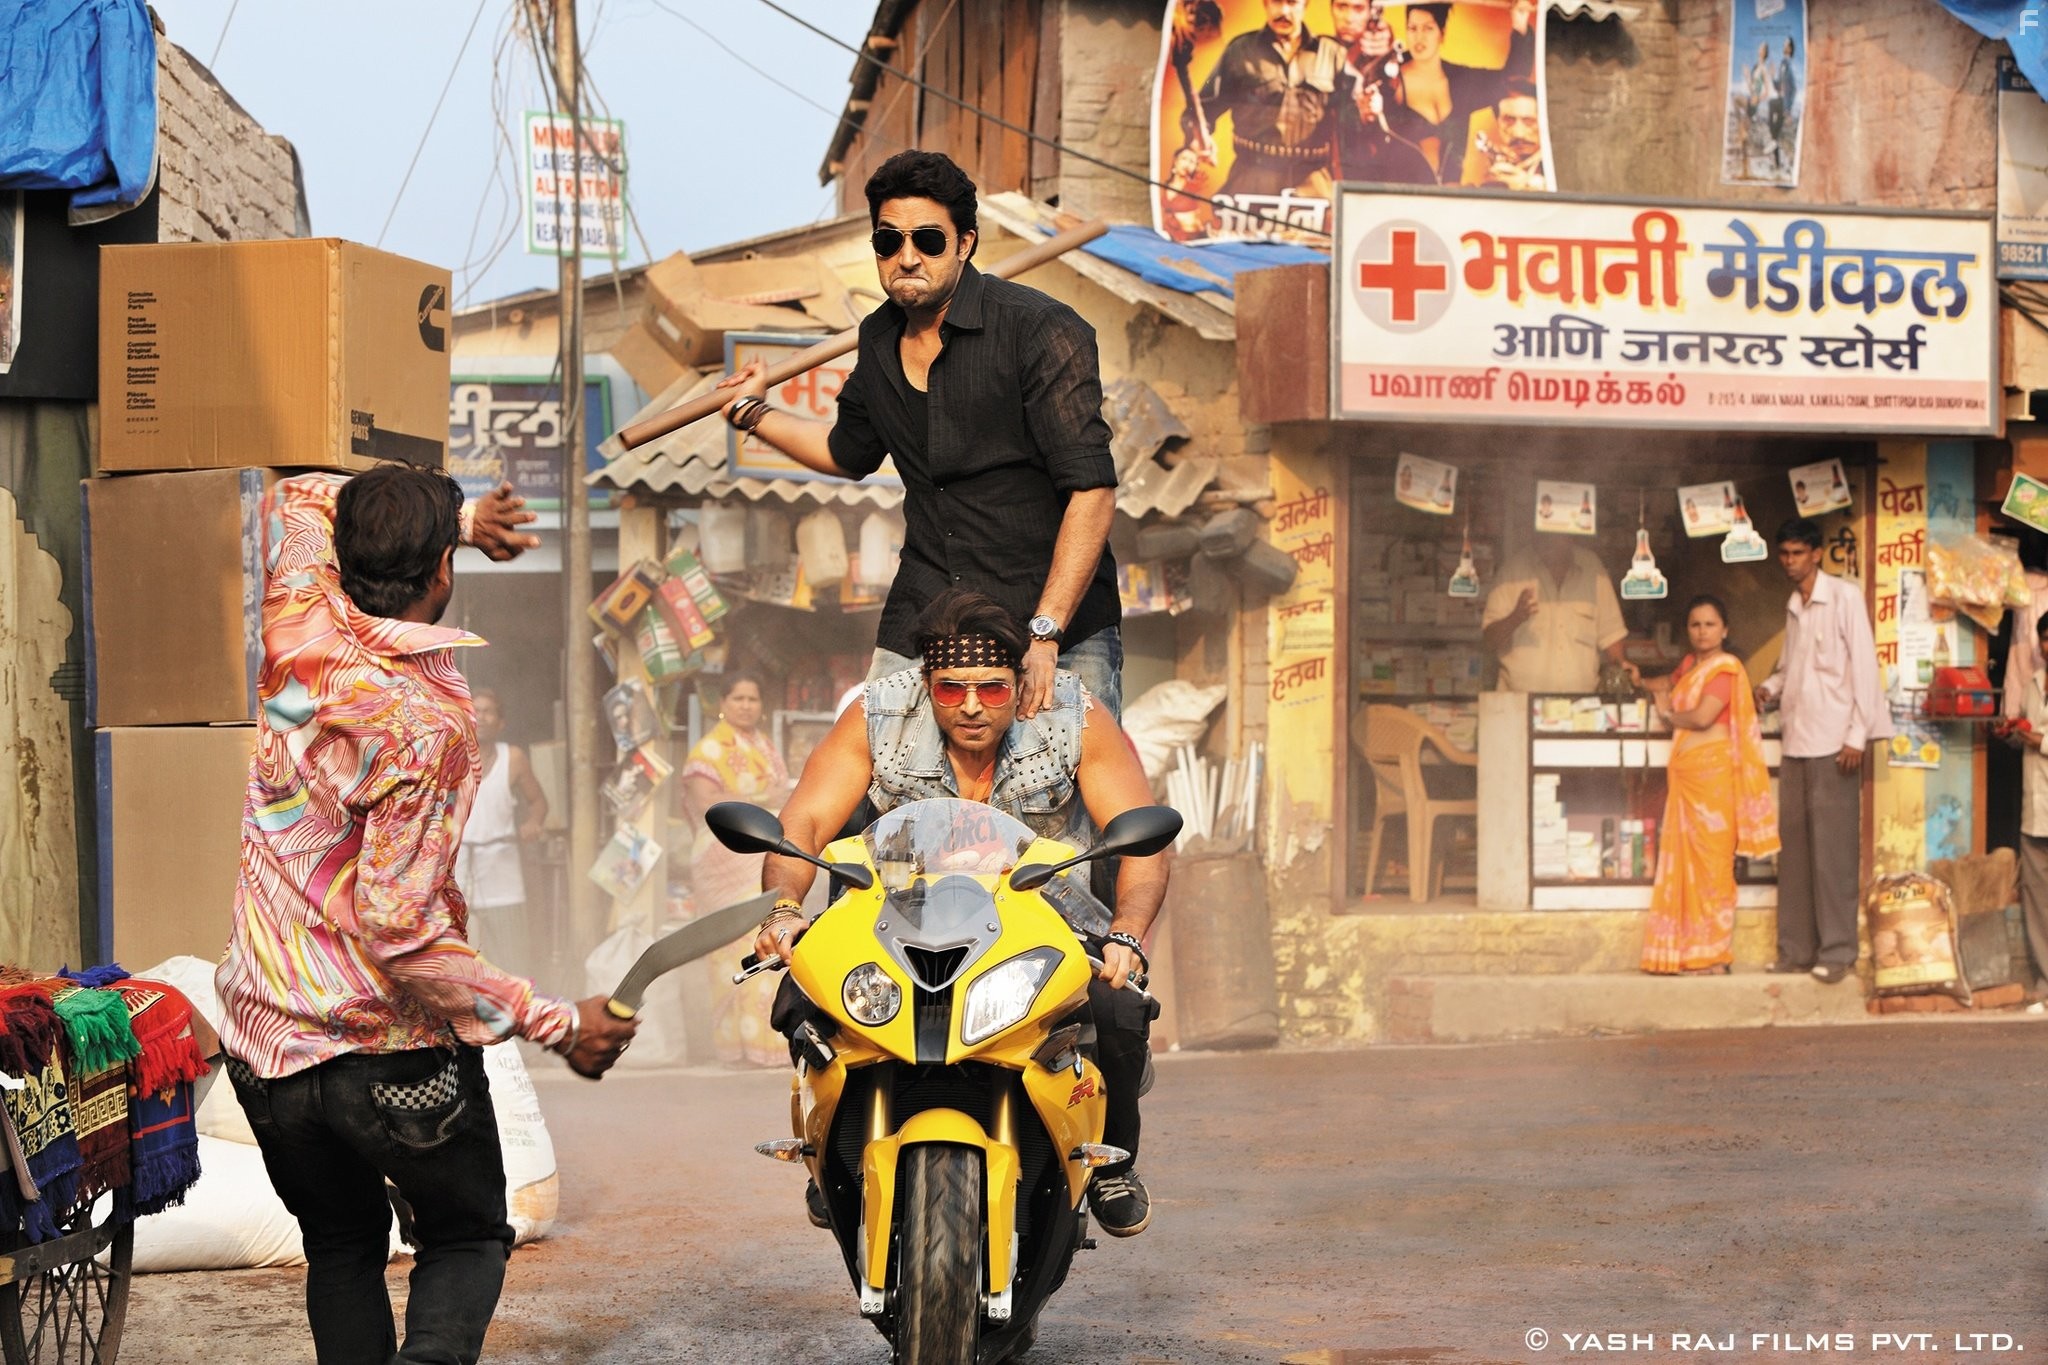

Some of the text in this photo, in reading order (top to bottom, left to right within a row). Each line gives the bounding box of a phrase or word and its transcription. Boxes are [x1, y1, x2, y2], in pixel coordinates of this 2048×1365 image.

[1461, 210, 1976, 318] भवानी मेडीकल
[1492, 314, 1927, 370] आणि जनरल स्टोर्स
[1369, 367, 1500, 399] பவாணி
[1508, 368, 1686, 409] மெடிக்கல்
